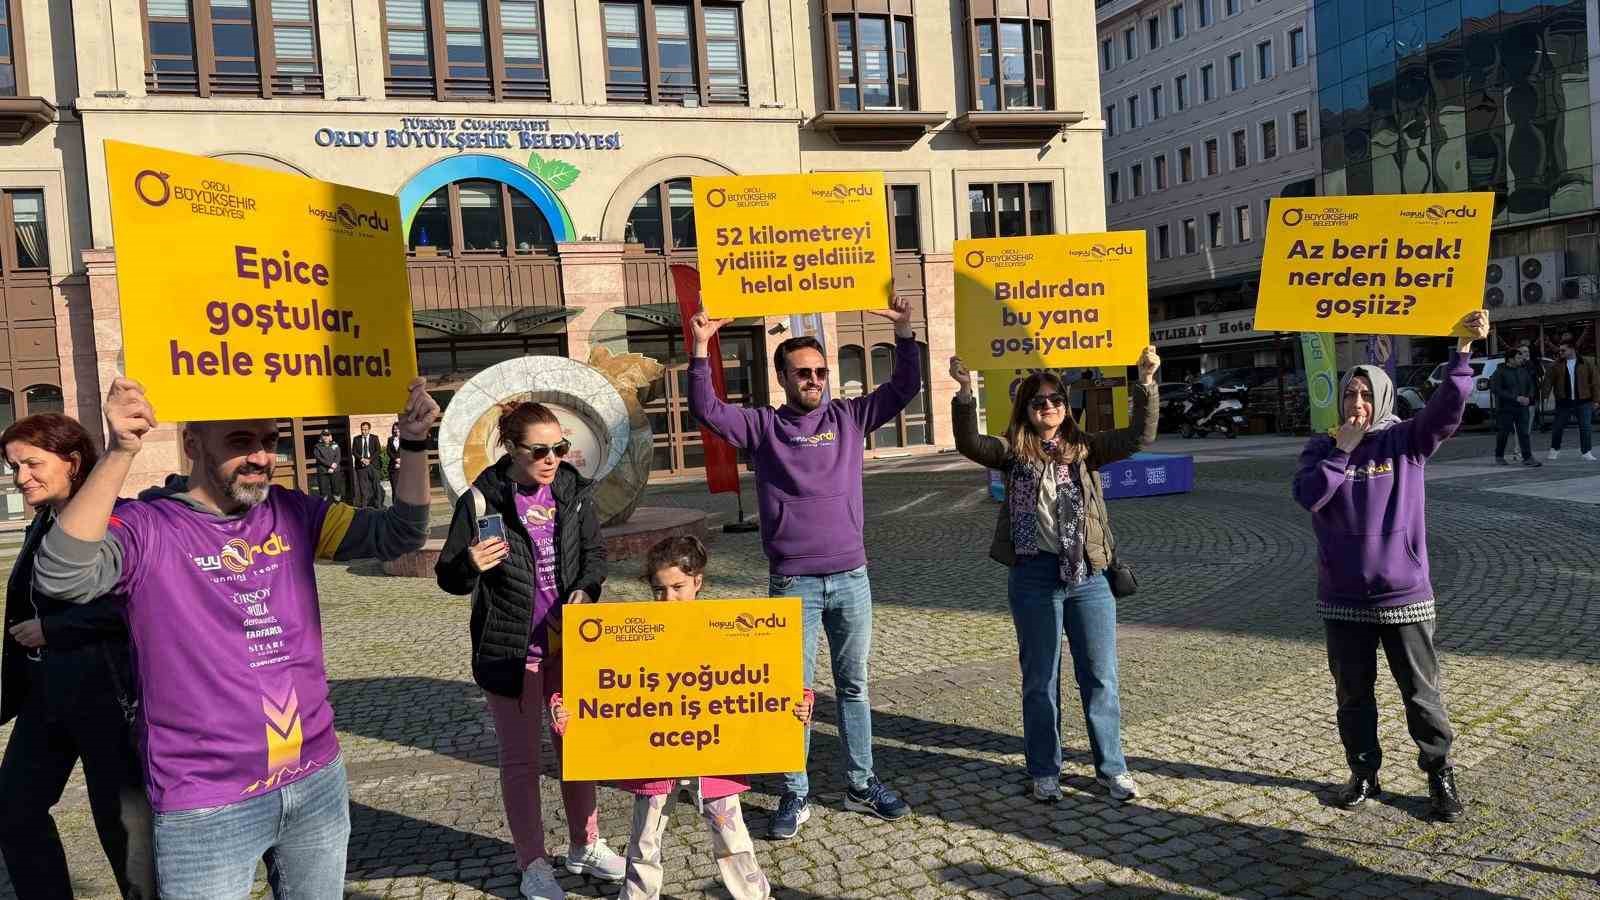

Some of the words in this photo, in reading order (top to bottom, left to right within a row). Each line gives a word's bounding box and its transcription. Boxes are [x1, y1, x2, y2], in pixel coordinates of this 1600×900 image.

[314, 127, 378, 148] ORDU
[386, 127, 512, 152] BÜYÜKŞEHİR
[519, 128, 622, 150] BELEDİYESİ
[716, 227, 743, 247] 52
[749, 221, 871, 245] kilometreyi
[1288, 240, 1323, 259] Az
[1333, 238, 1387, 259] beri
[1397, 238, 1461, 259] bak!
[236, 246, 328, 289] Epice
[716, 250, 787, 277] yidiiiiz
[793, 248, 874, 270] geldiiiiz
[742, 274, 792, 293] helal
[799, 270, 854, 290] olsun
[1289, 266, 1385, 286] nerden
[1395, 267, 1453, 287] beri
[994, 279, 1104, 301] Bıldırdan
[206, 299, 360, 339] goştular,
[1000, 307, 1031, 327] bu
[1039, 309, 1098, 329] yana
[1316, 294, 1416, 318] goşiiz?
[990, 329, 1113, 357] goşiyalar!
[170, 340, 253, 376] hele
[264, 345, 391, 382] şunlara!
[599, 669, 631, 689] Bu
[640, 667, 659, 692] iş
[666, 663, 769, 694] yoğudu!
[579, 696, 672, 719] Nerden
[681, 695, 701, 720] iş
[709, 690, 790, 714] ettiler
[650, 724, 719, 751] acep!
